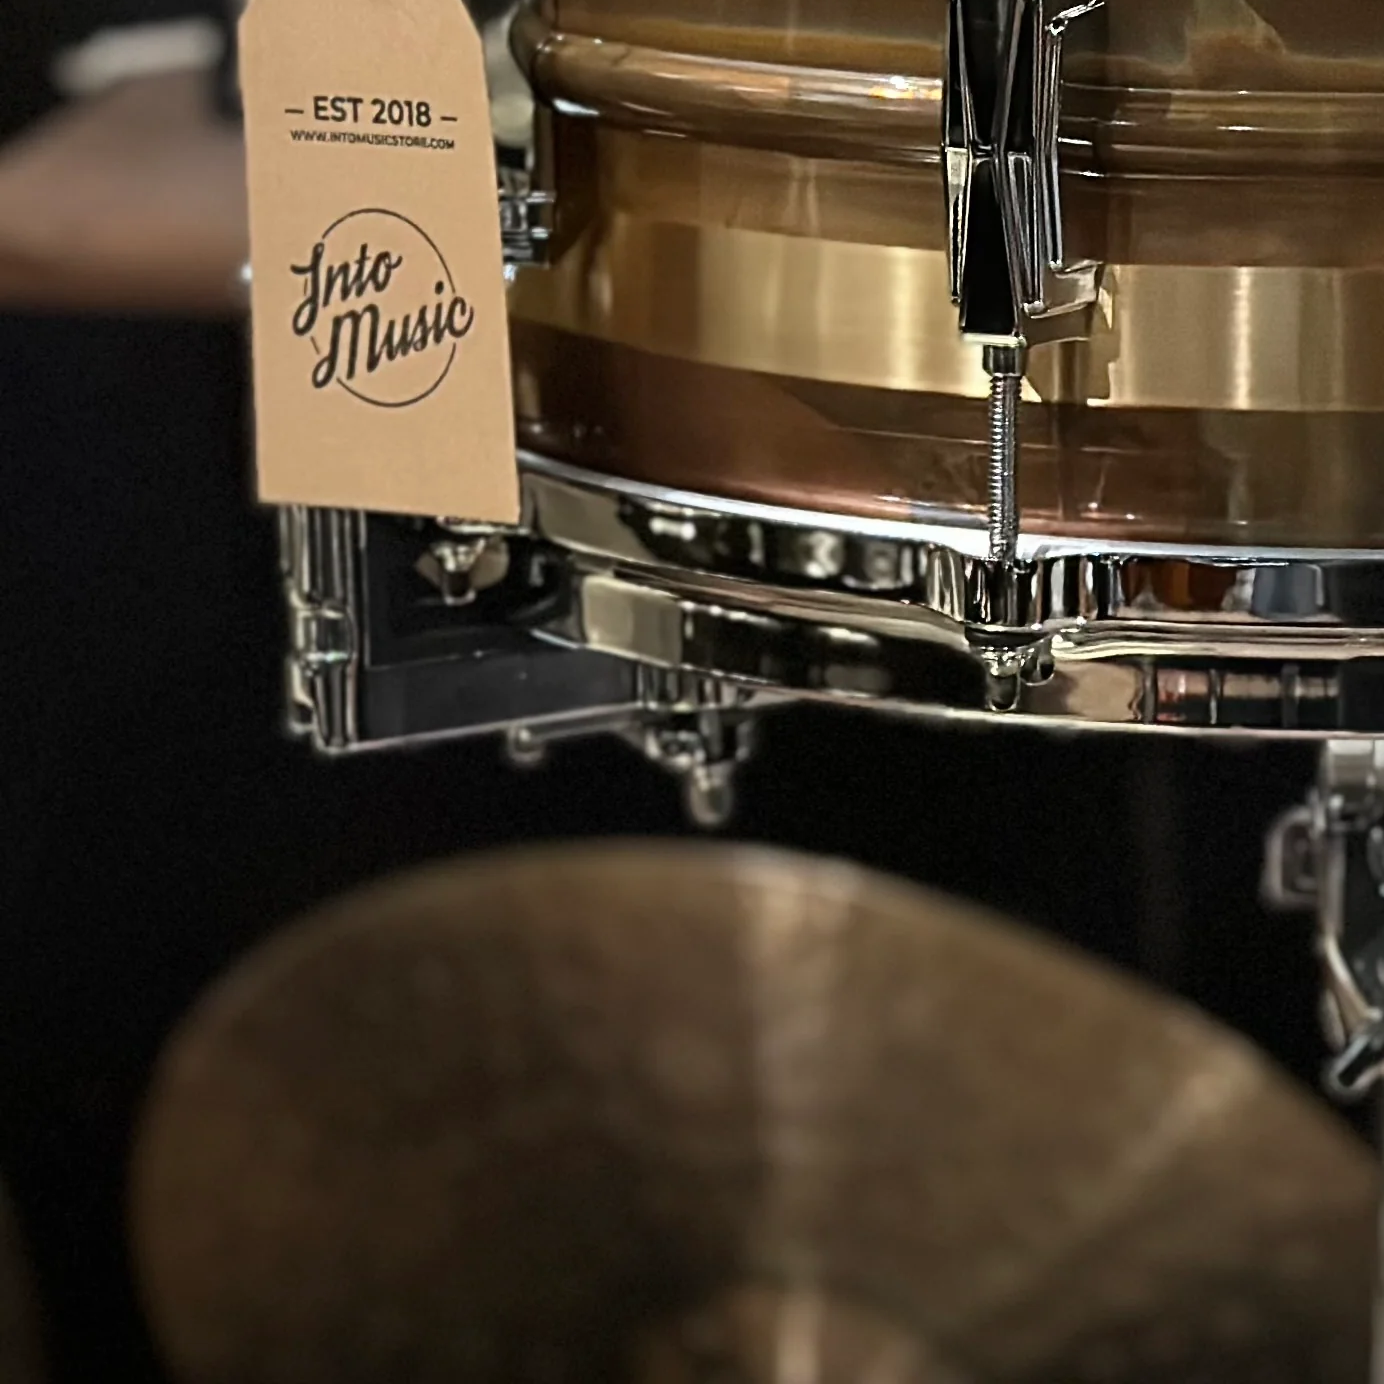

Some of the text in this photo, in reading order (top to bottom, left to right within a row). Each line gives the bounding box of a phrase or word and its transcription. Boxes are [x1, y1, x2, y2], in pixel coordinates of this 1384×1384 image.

[313, 96, 432, 127] EST 2018
[290, 242, 403, 336] Into
[311, 280, 474, 388] Music
